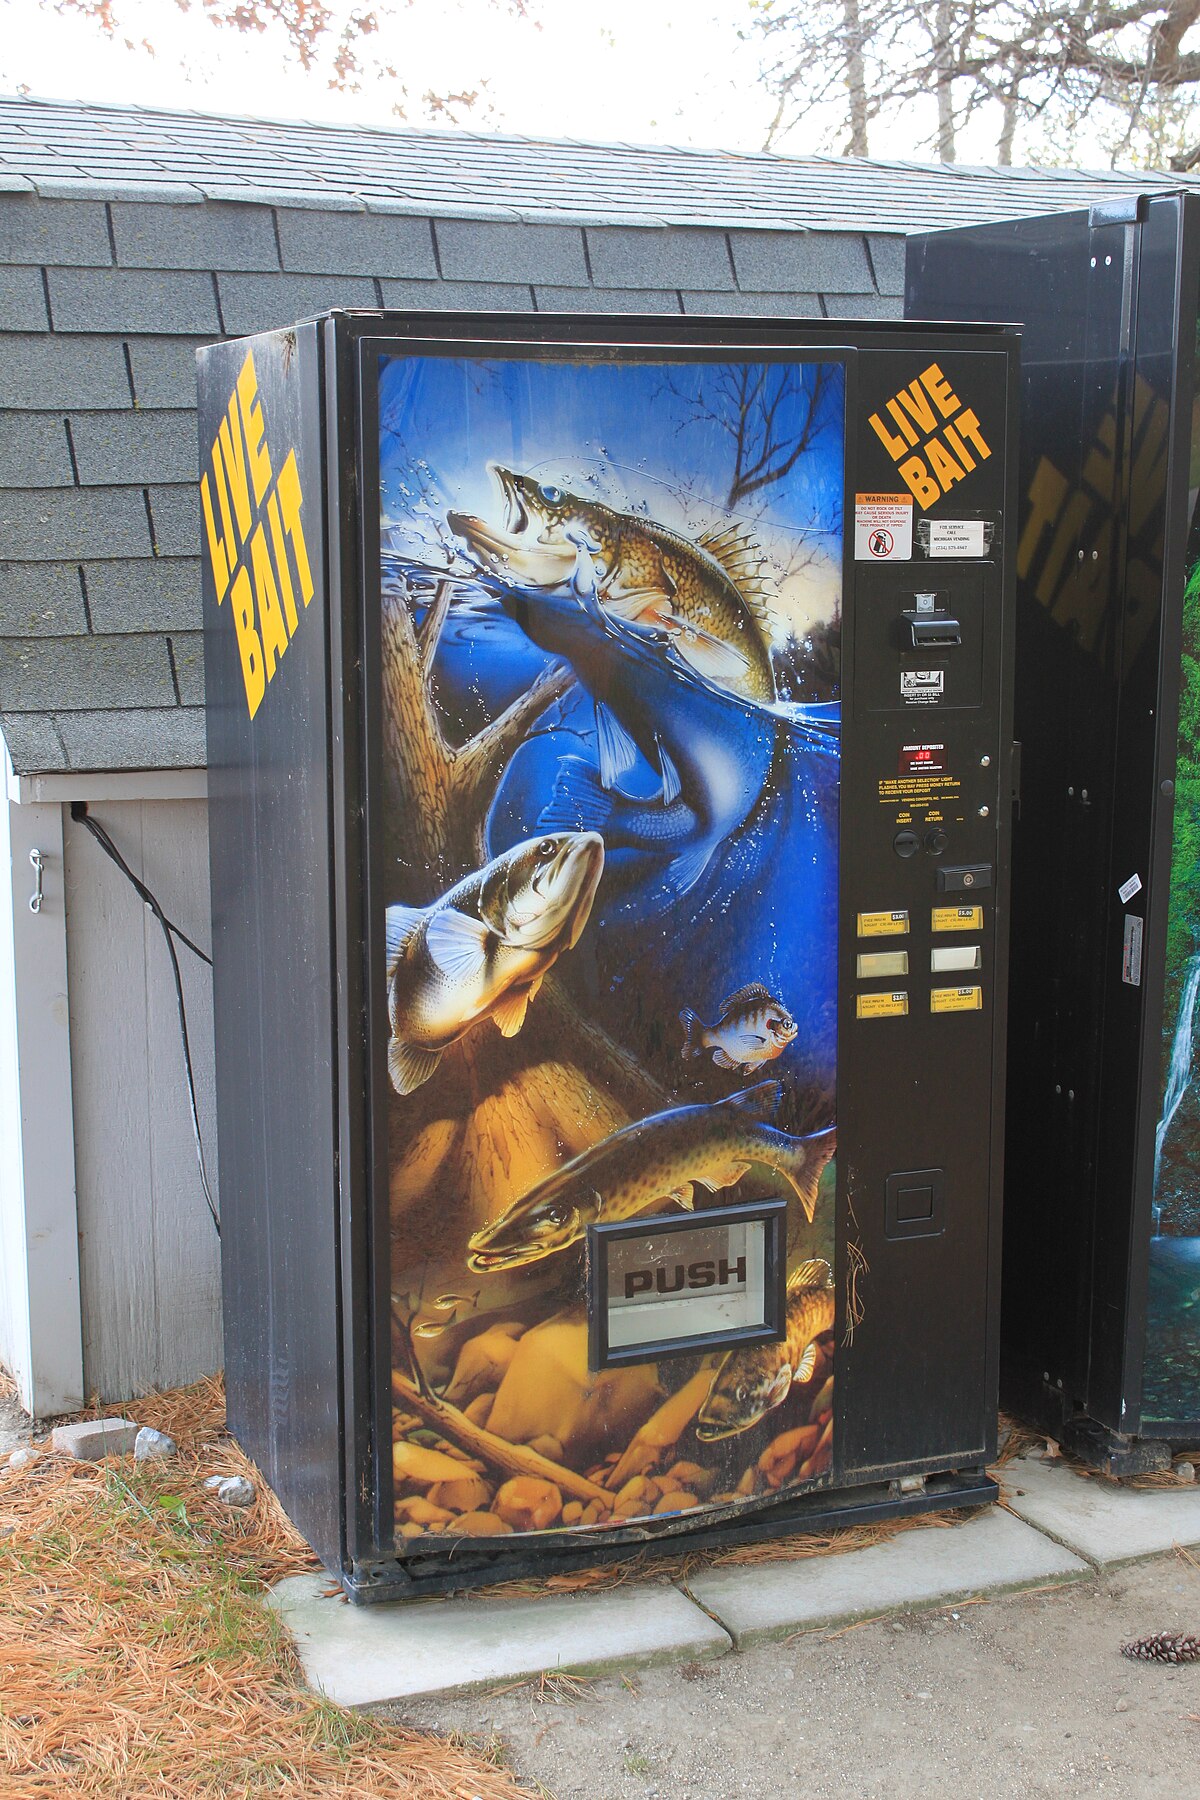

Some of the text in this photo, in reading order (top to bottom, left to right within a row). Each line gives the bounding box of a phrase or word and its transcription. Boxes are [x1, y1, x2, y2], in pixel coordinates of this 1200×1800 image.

[868, 363, 962, 462] LIVE
[898, 408, 992, 511] BAIT
[200, 347, 272, 606] LIVE
[230, 447, 314, 721] BAIT
[625, 1257, 746, 1298] PUSH
